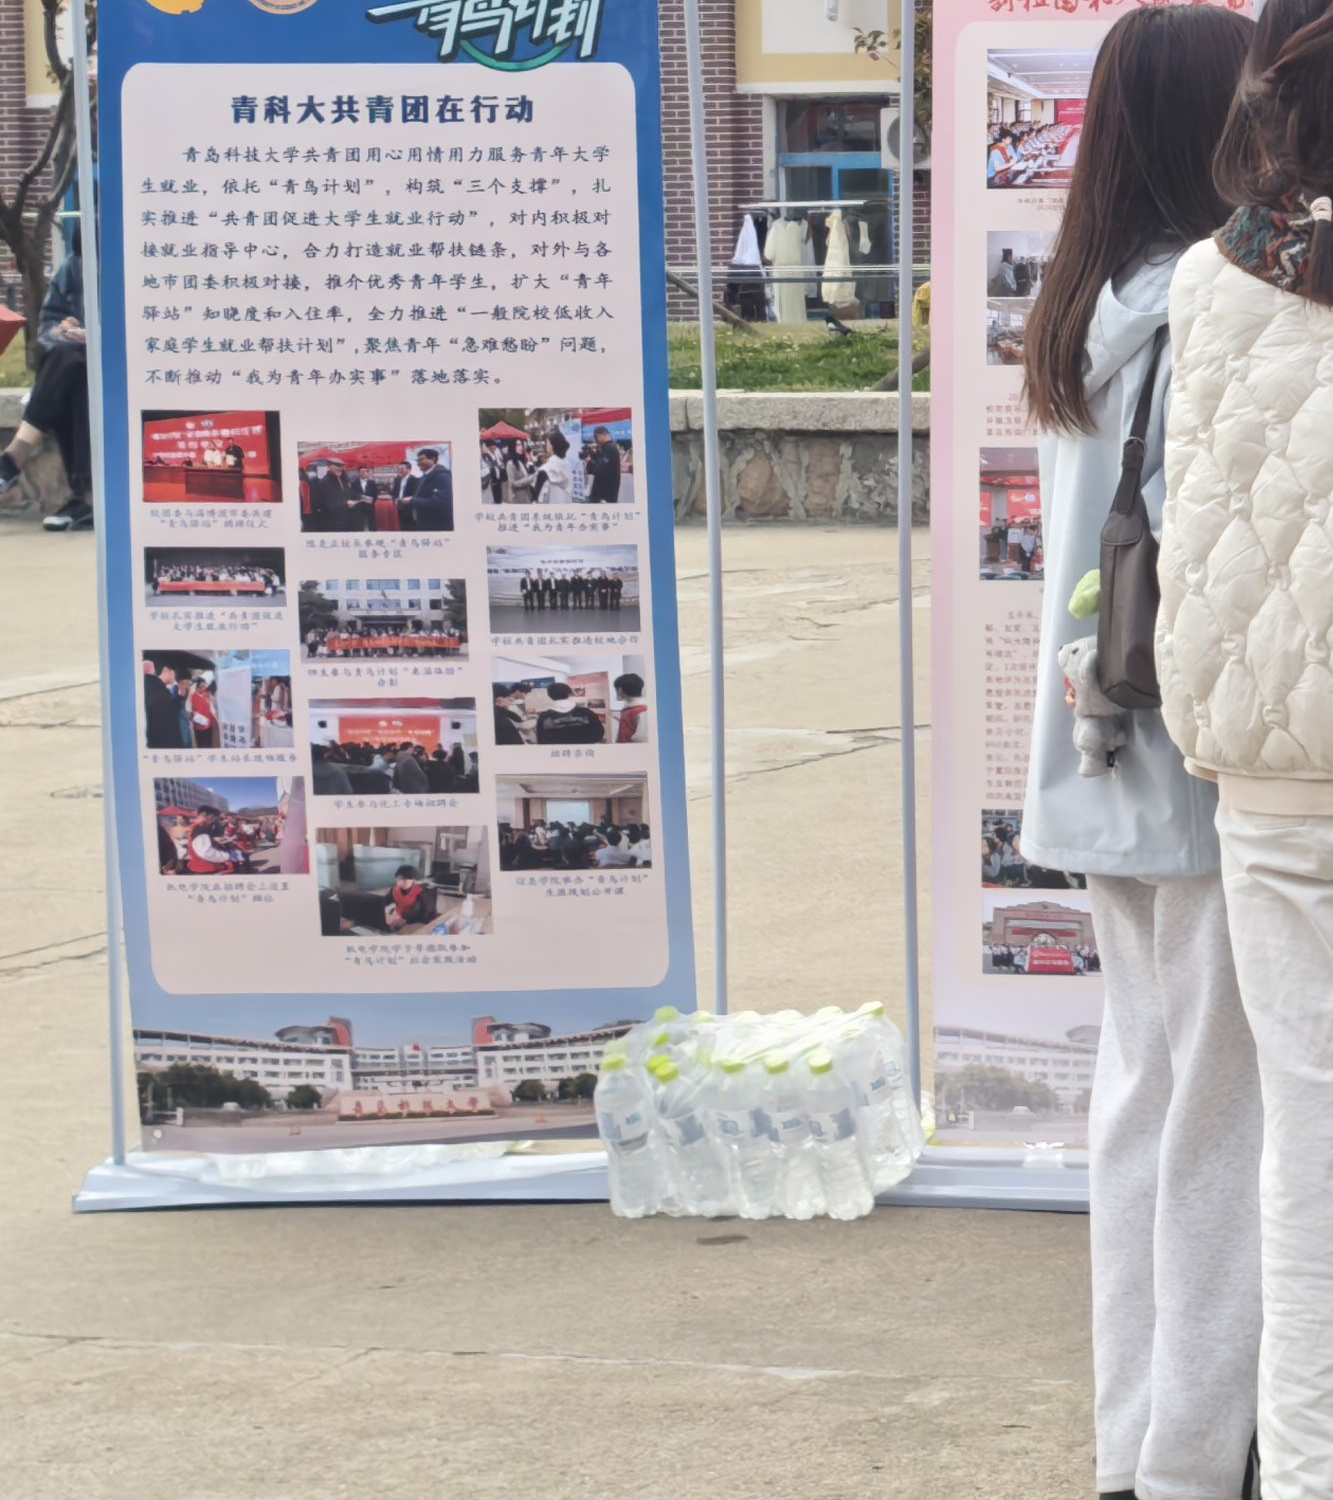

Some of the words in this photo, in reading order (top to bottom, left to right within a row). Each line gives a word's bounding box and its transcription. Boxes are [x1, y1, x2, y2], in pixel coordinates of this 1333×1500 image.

[230, 94, 535, 125] 青科大共青团在行动
[182, 146, 610, 164] 青岛科技大学共青团用心用情用力服务青年大学
